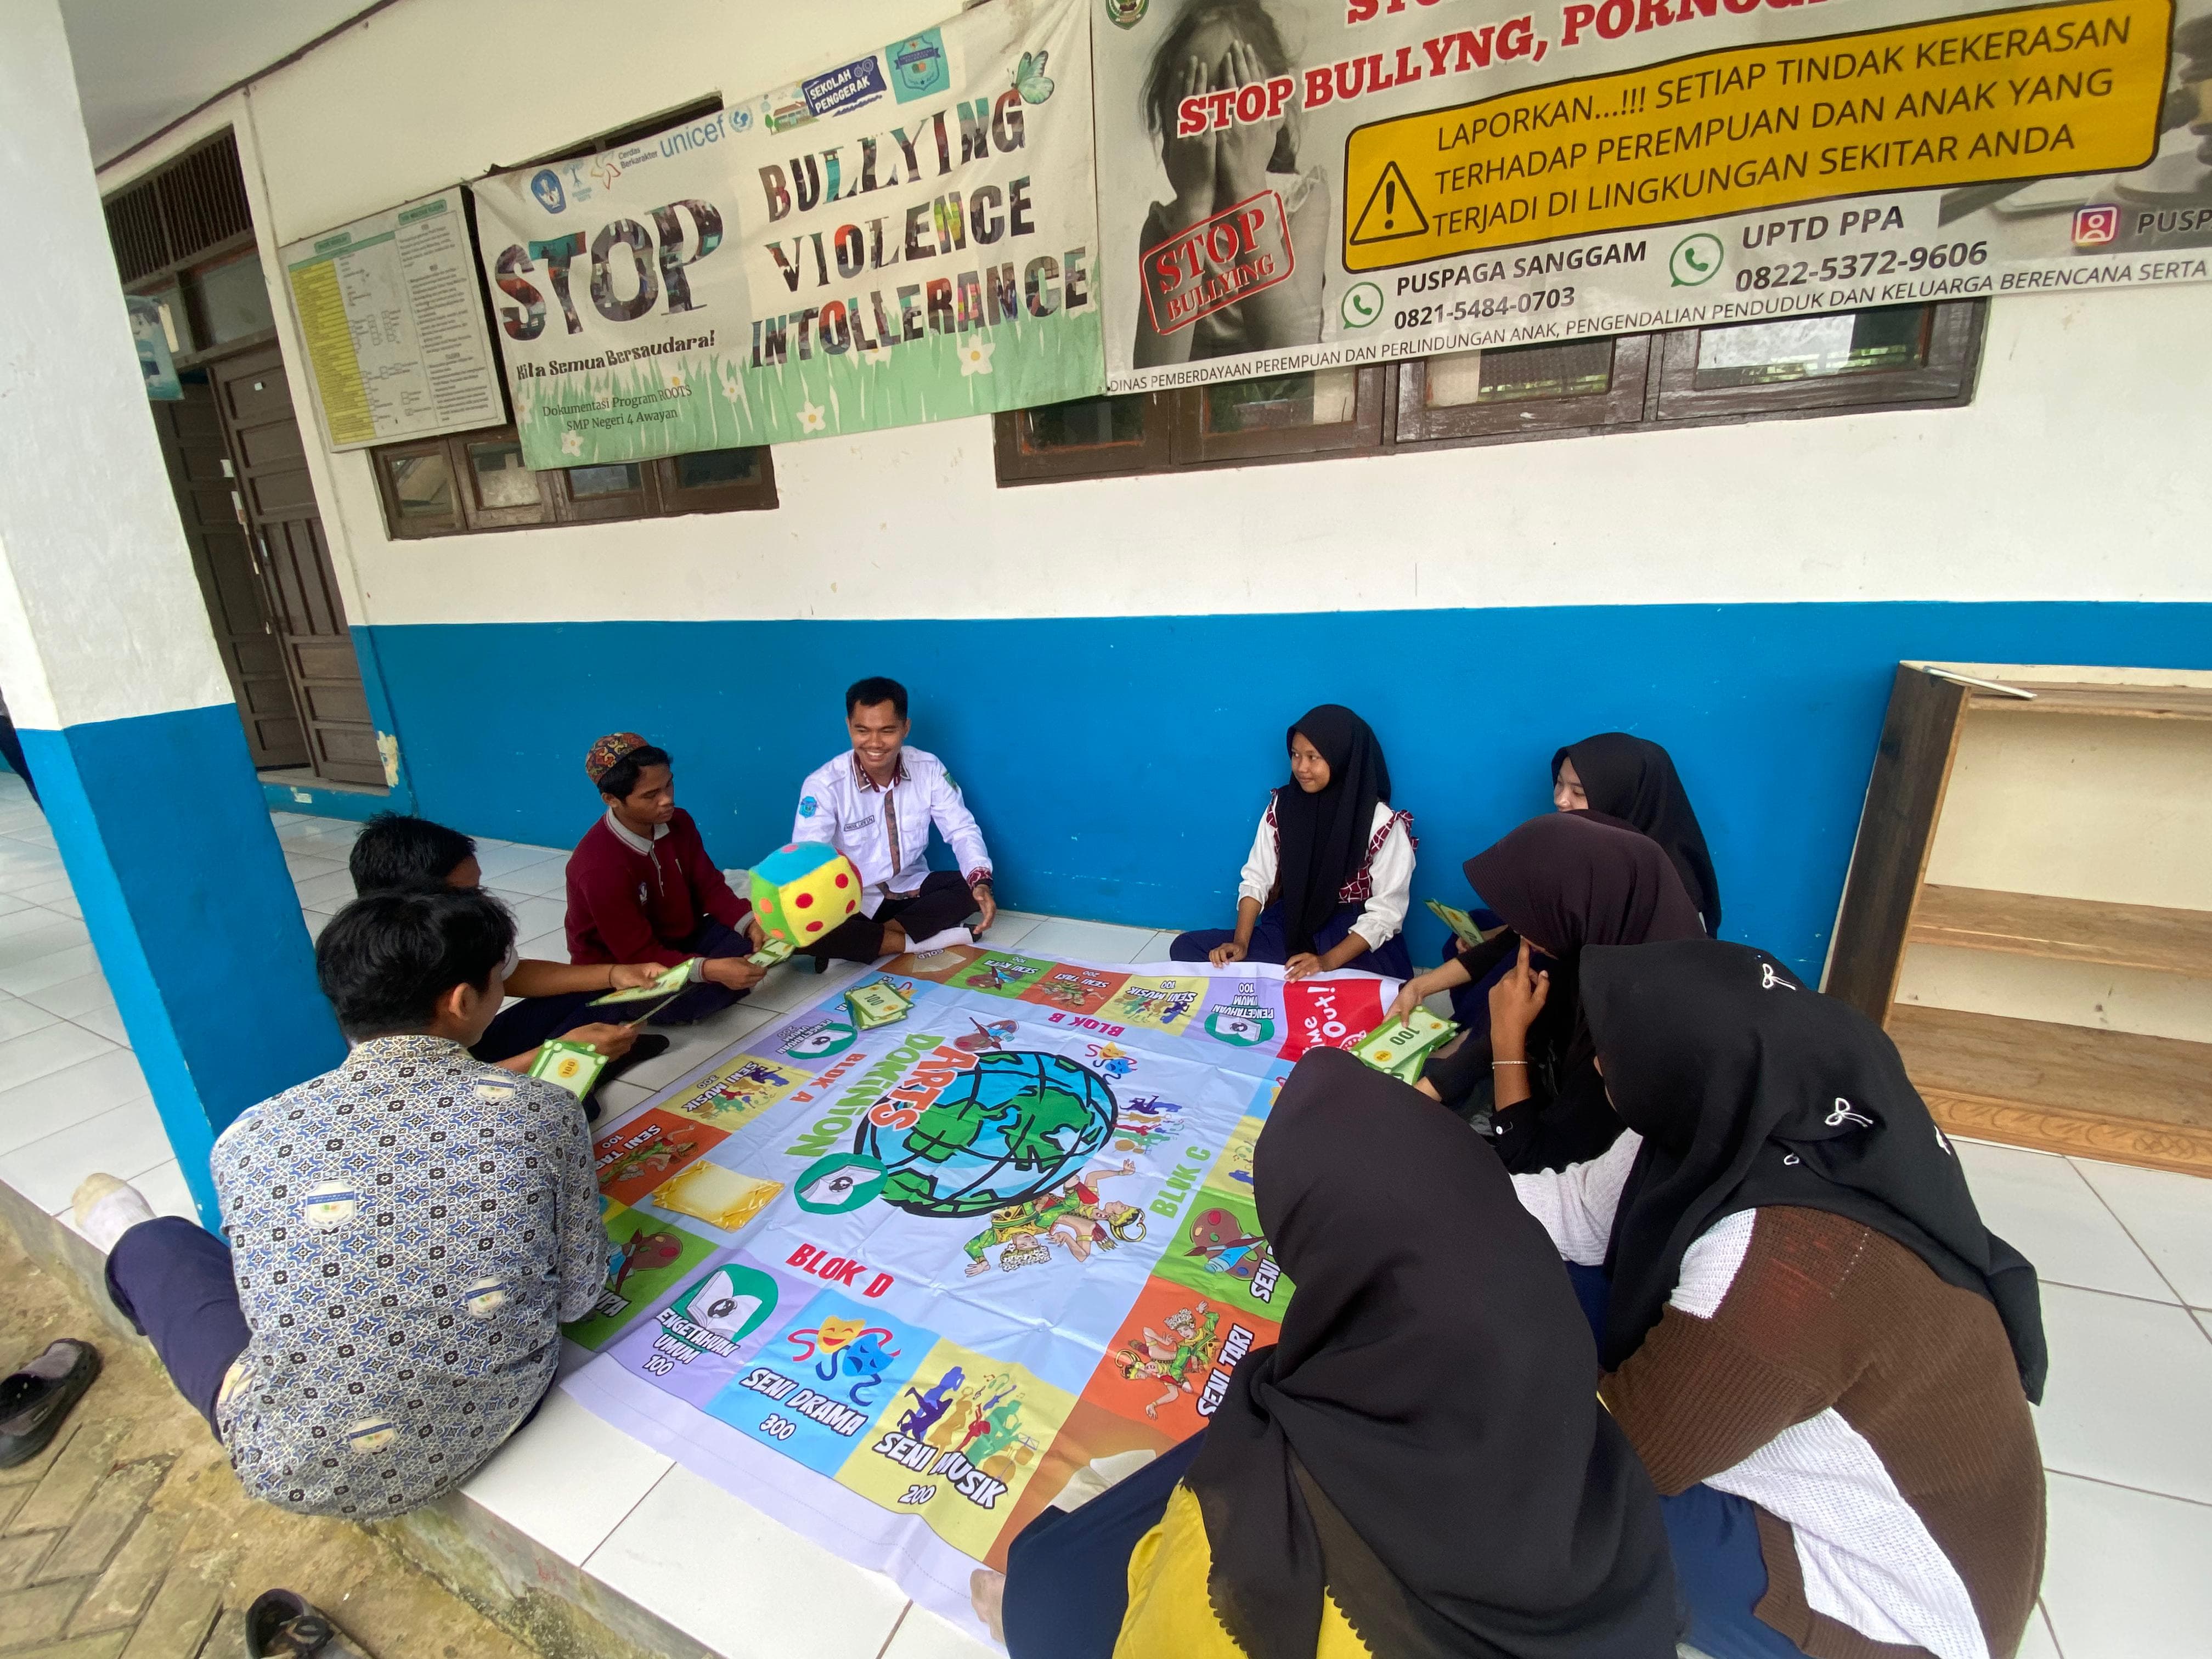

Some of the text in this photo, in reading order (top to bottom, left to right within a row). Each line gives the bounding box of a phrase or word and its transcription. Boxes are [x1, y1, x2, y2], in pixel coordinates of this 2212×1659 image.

[1180, 78, 1294, 135] STOP
[1305, 15, 1548, 109] BULLYNG,
[1656, 63, 1765, 109] SETIAP
[1776, 46, 1904, 84] TINDAK
[1916, 15, 2131, 69] KEKERASAN
[810, 69, 851, 100] SEKOLAH
[815, 76, 870, 112] PENGGERAK
[660, 116, 725, 157] unicef
[1436, 68, 2113, 194] TERHADAP PEREMPUAN DAN ANAK YANG
[618, 148, 640, 159] Cerdas
[620, 151, 658, 168] Berkarakter
[758, 89, 1025, 222] BULLYING
[1432, 123, 2075, 236] TERJADI DI LINGKUNGAN SEKITAR ANDA
[764, 175, 1035, 292] VIOLENCE
[1742, 206, 1904, 249] UPTD PPA
[2137, 209, 2212, 234] PUSP
[495, 199, 723, 341] STOP
[1156, 208, 1265, 294] STOP
[1396, 240, 1647, 296] PUSPAGA SANGGAM
[1736, 241, 1988, 292] 0822-5372-9606
[751, 246, 1087, 368] INTOLLERANCE
[1166, 253, 1275, 321] BULLYING
[1394, 286, 1575, 329] 0821-5484-0703
[1110, 260, 2207, 391] DINAS PEMBERDAYAAN PEREMPUAN DAN PERLINDUNGAN ANAK, PENGENDALIAN PENDUDUK DAN KELUARGA BERENCANA SERTA
[516, 330, 715, 380] Kita Semua Bersaudara!
[542, 385, 692, 417] Dokumentasi Program ROOTS
[566, 409, 679, 432] SMP Negeri 4 Awayan
[984, 959, 1041, 974] SENI RUPA
[1054, 973, 1110, 988] SENI TARI
[1160, 980, 1176, 989] 100
[864, 994, 884, 1006] 100
[1126, 986, 1198, 1003] SENI MUSIK
[1232, 995, 1259, 1007] UMUM
[1238, 983, 1255, 994] 100
[777, 1025, 795, 1037] 200
[1048, 1013, 1125, 1037] BLOK B
[1211, 1003, 1275, 1020] PENGETAHUAN
[1307, 986, 1346, 1038] Out!
[775, 1019, 833, 1054] PENGETAHUAN
[782, 1025, 810, 1042] UMUM
[1389, 1026, 1420, 1046] 100
[562, 1061, 575, 1074] 100
[681, 1061, 759, 1112] SENI MUSIK
[697, 1075, 719, 1089] 300
[790, 1053, 868, 1103] BLOK A
[868, 1045, 980, 1131] ARTS
[595, 1124, 662, 1171] SENI TAR
[602, 1135, 625, 1148] 100
[1149, 1146, 1211, 1219] BLOK C
[786, 1242, 894, 1298] BLOK D
[1250, 1258, 1280, 1304] SENI
[653, 1333, 702, 1364] UMUM
[656, 1307, 741, 1358] ENGETAHUAN
[642, 1355, 674, 1376] 100
[1196, 1323, 1255, 1417] SENI TARI
[739, 1368, 868, 1437] SENI DRAMA
[760, 1413, 796, 1440] 300
[872, 1431, 1008, 1509] SENI MUSIK
[898, 1485, 936, 1505] 200
